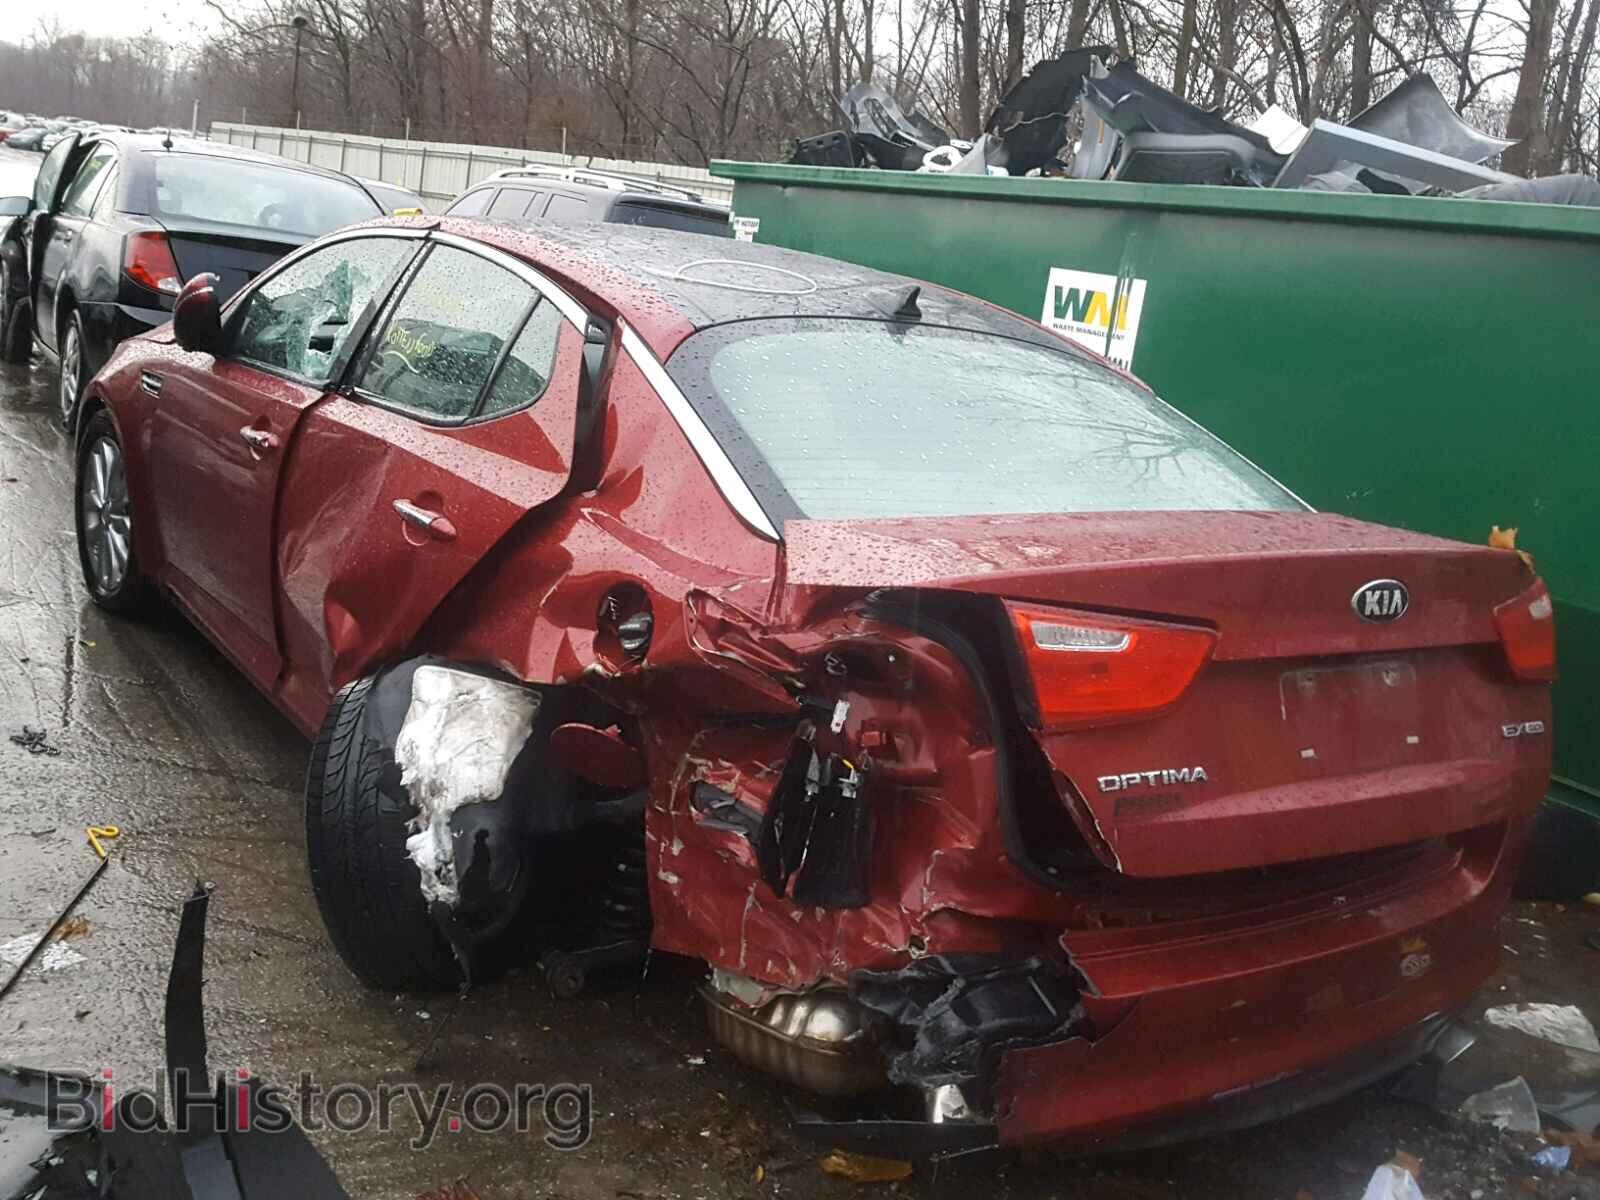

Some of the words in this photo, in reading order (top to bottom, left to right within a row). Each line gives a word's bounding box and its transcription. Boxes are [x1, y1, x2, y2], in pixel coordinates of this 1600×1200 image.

[1054, 285, 1128, 331] WM
[1053, 323, 1074, 332] WASTE
[1076, 327, 1125, 340] MANAGEENT
[1365, 590, 1402, 615] KIA
[1097, 766, 1208, 793] OPTIMA
